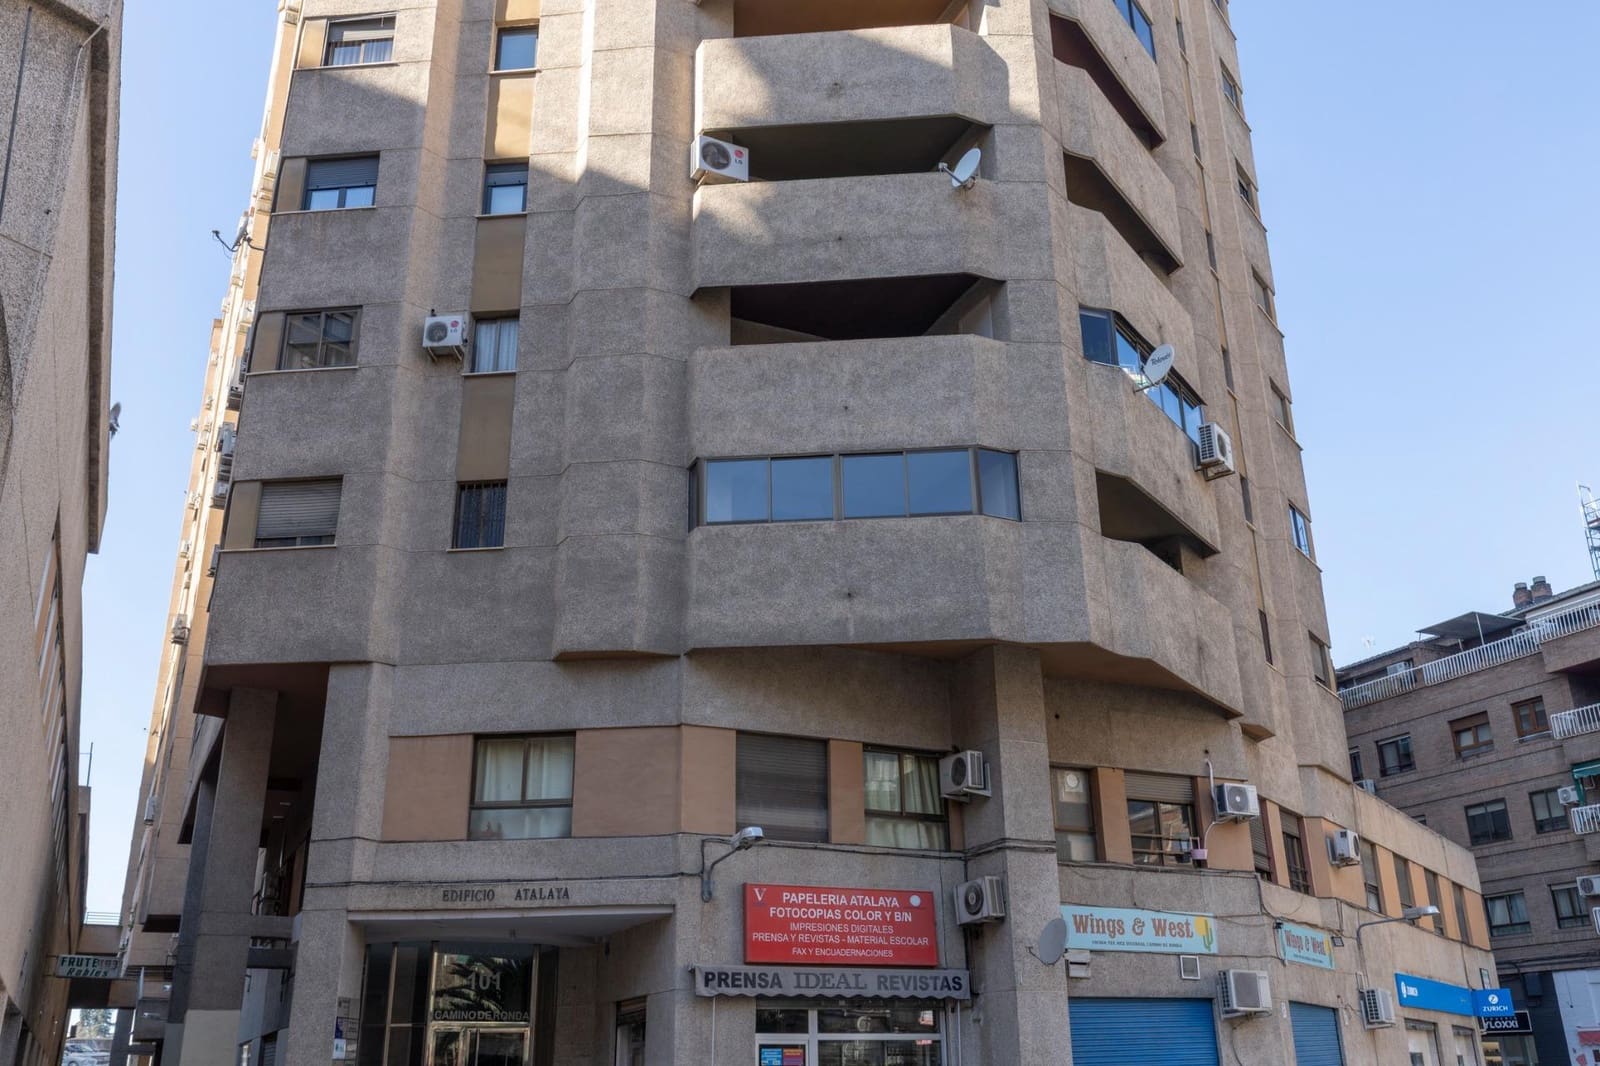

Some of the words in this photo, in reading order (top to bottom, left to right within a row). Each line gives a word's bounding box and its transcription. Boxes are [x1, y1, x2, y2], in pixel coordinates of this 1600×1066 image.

[442, 889, 496, 902] EDIFICIO
[514, 887, 570, 900] ATALAYA
[783, 892, 848, 906] PAPELERIA
[850, 895, 900, 908] ATALAYA
[770, 907, 842, 920] FOTOCOPIAS
[844, 910, 882, 921] COLOR
[884, 911, 892, 922] Y
[894, 911, 912, 922] B/N
[790, 922, 849, 933] IMPRESIONES
[851, 924, 894, 934] DIGITALES
[1072, 913, 1125, 938] Wings
[1132, 917, 1146, 936] &
[1152, 917, 1194, 938] West
[753, 932, 788, 943] PRENSA
[790, 933, 797, 941] Y
[799, 933, 840, 943] REVISTAS
[847, 935, 888, 945] MATERIAL
[890, 936, 929, 946] ESCOLAR
[792, 947, 807, 956] FAX
[808, 948, 814, 956] Y
[815, 948, 894, 958] ENCUADERNACIONES
[467, 971, 501, 990] 101
[703, 972, 782, 989] PRENSA
[793, 972, 867, 991] IDEAL
[877, 975, 963, 991] REVISTAS
[434, 1010, 477, 1021] CAMINO
[478, 1010, 492, 1021] DE
[493, 1010, 530, 1021] RONDA
